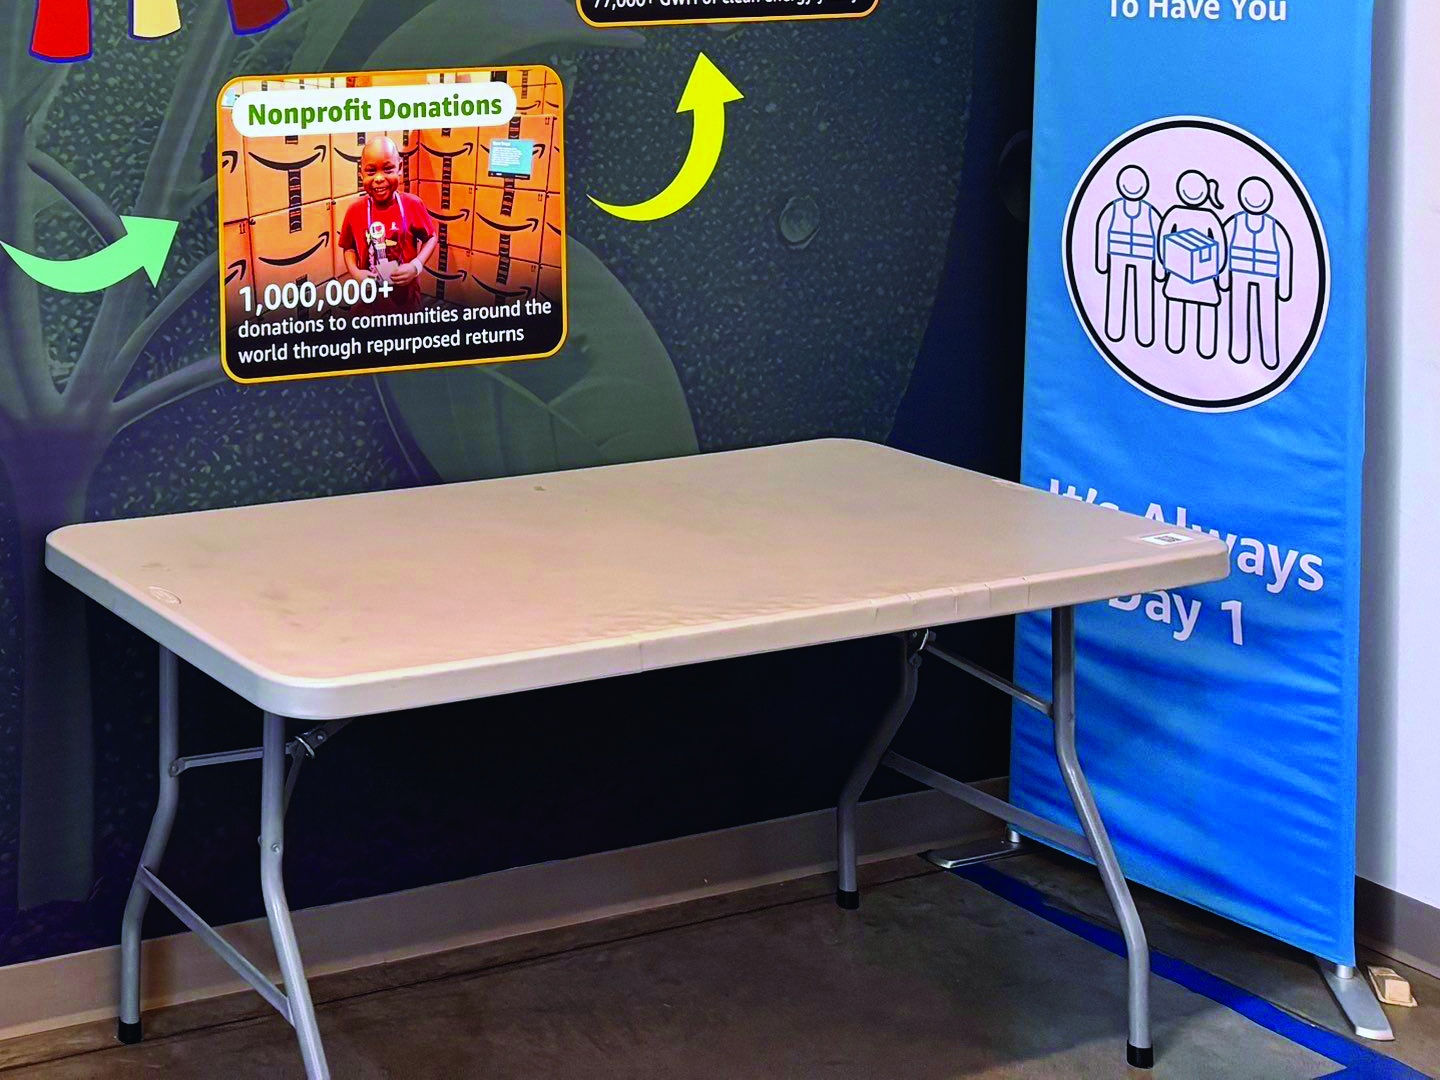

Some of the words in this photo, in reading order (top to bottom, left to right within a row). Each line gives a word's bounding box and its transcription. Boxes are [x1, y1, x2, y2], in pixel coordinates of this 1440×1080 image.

[248, 98, 372, 129] Nonprofit
[379, 93, 502, 119] Donations
[239, 278, 394, 316] 1,000,000+
[238, 317, 323, 338] donations
[328, 316, 347, 332] to
[351, 308, 459, 330] communities
[462, 304, 522, 321] around
[524, 298, 552, 316] the
[238, 343, 288, 364] world
[293, 339, 362, 361] through
[366, 330, 460, 357] repurposed
[465, 327, 525, 344] returns
[1221, 600, 1243, 646] 1
